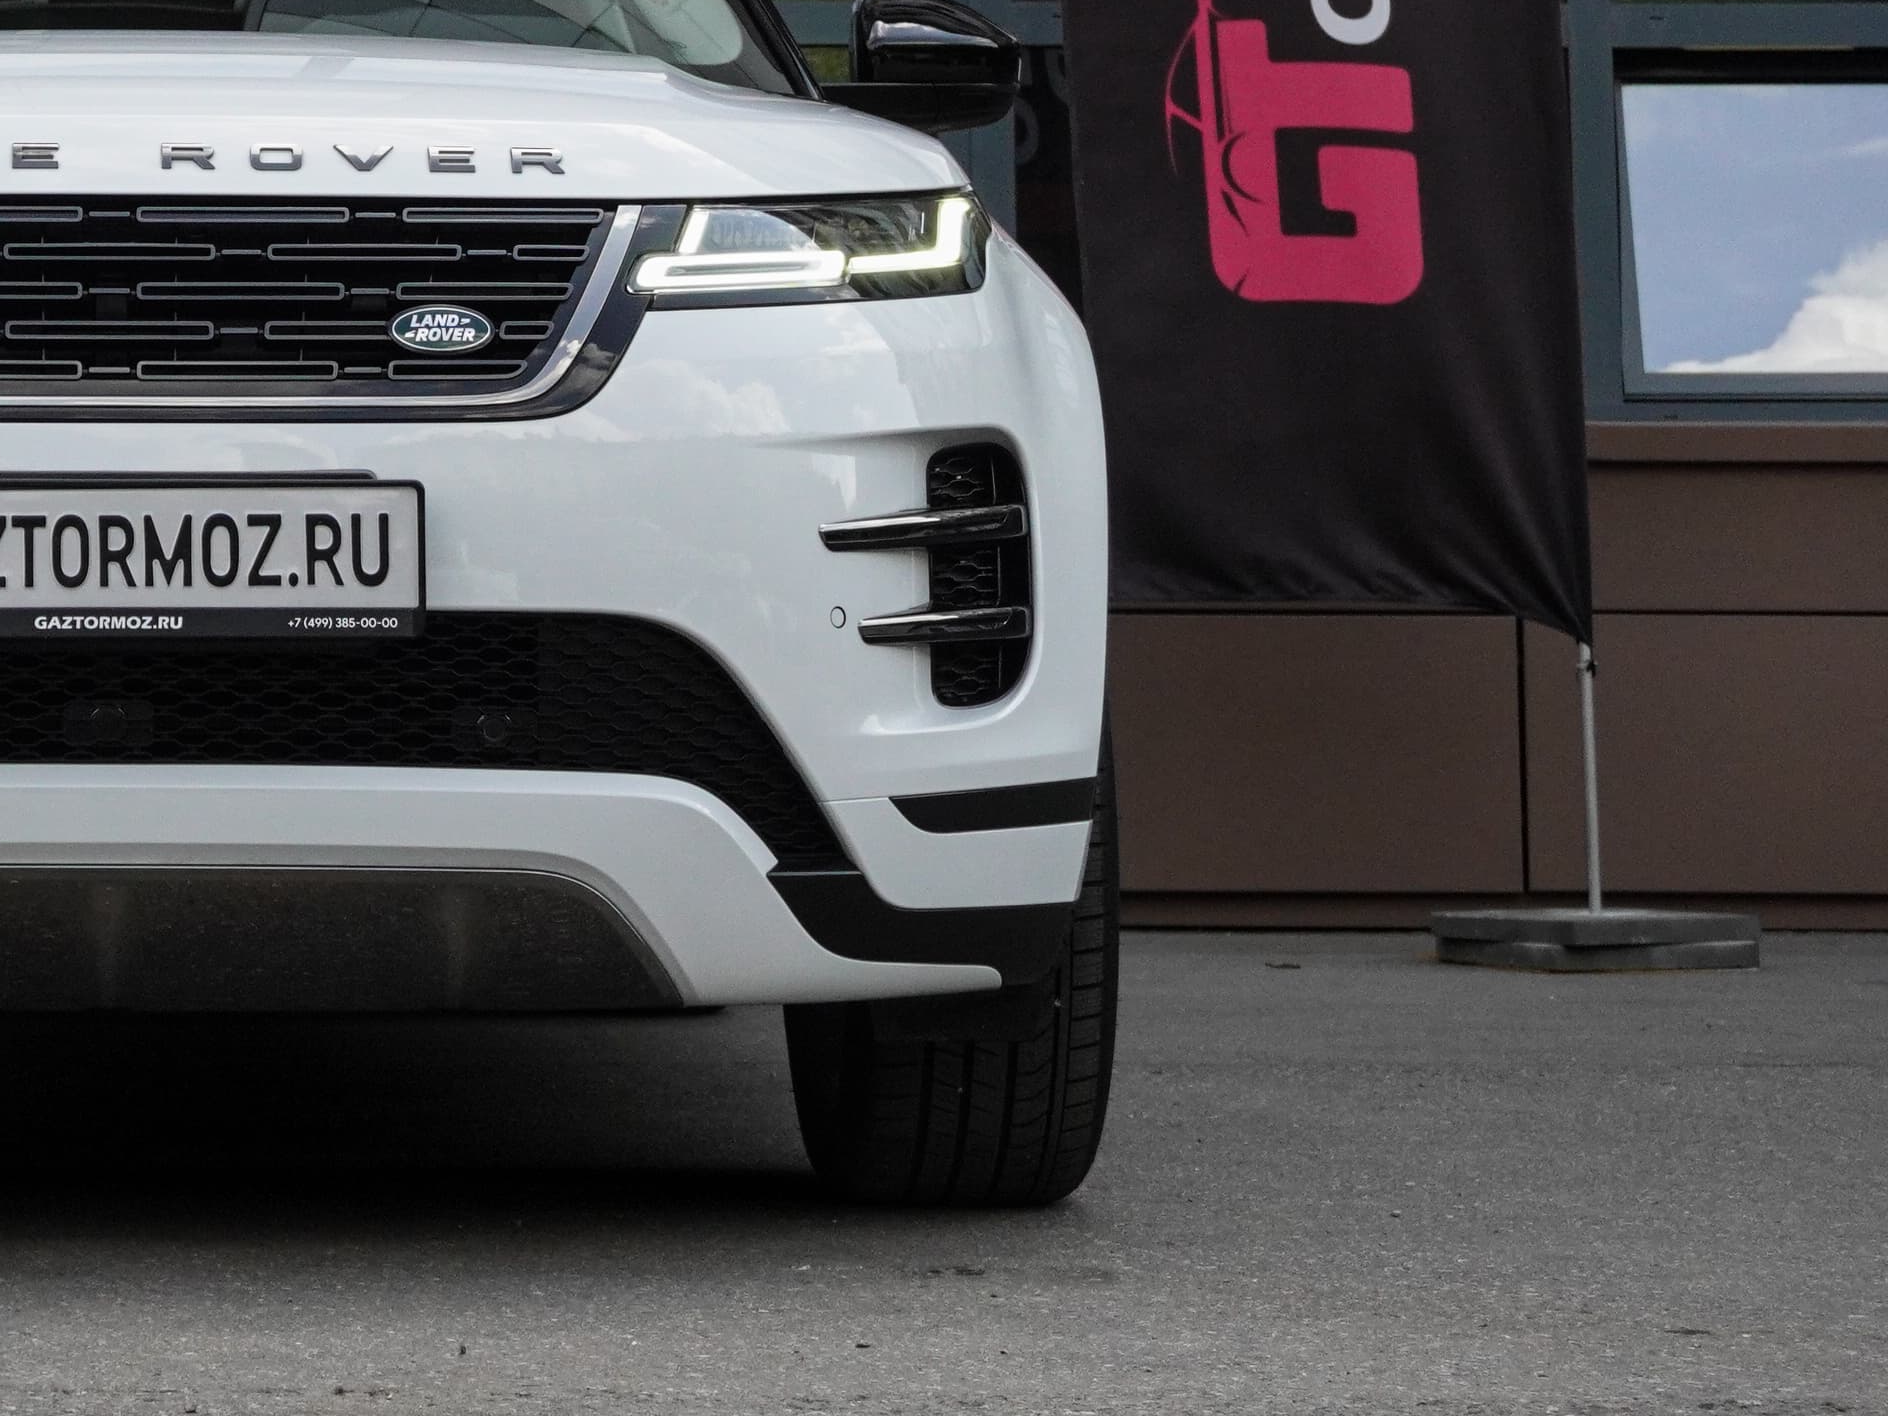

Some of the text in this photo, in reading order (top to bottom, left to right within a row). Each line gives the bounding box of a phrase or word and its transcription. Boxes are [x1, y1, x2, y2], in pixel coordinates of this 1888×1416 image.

[160, 142, 566, 175] ROVER
[410, 314, 460, 327] LAND
[415, 328, 476, 342] ROVER
[34, 616, 184, 630] GAZTORMOZ.RU
[288, 616, 399, 629] +7 (499) 385-00-00
